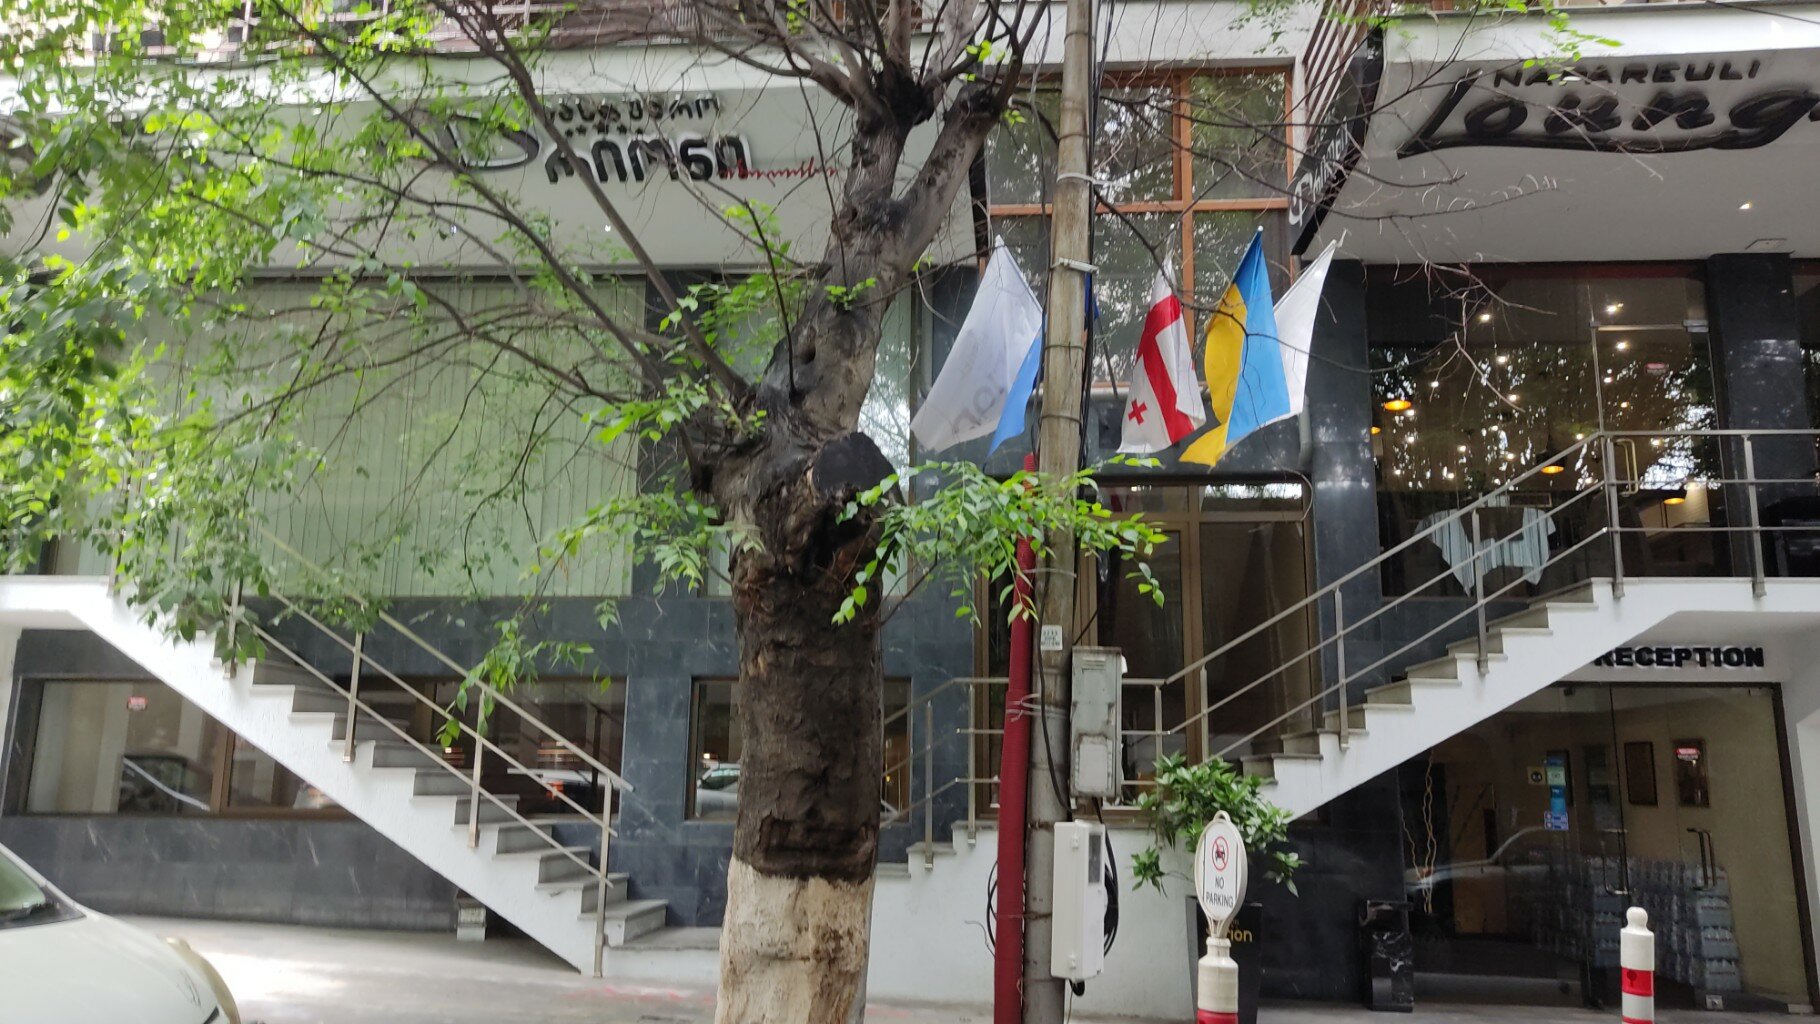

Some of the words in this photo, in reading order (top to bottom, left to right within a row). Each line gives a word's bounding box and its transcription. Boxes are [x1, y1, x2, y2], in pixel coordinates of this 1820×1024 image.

[549, 97, 719, 123] ასტუმრო
[1398, 68, 1820, 160] Loung
[1594, 647, 1764, 667] RECEPTION
[1215, 876, 1225, 889] NO
[1206, 891, 1233, 908] PARKING
